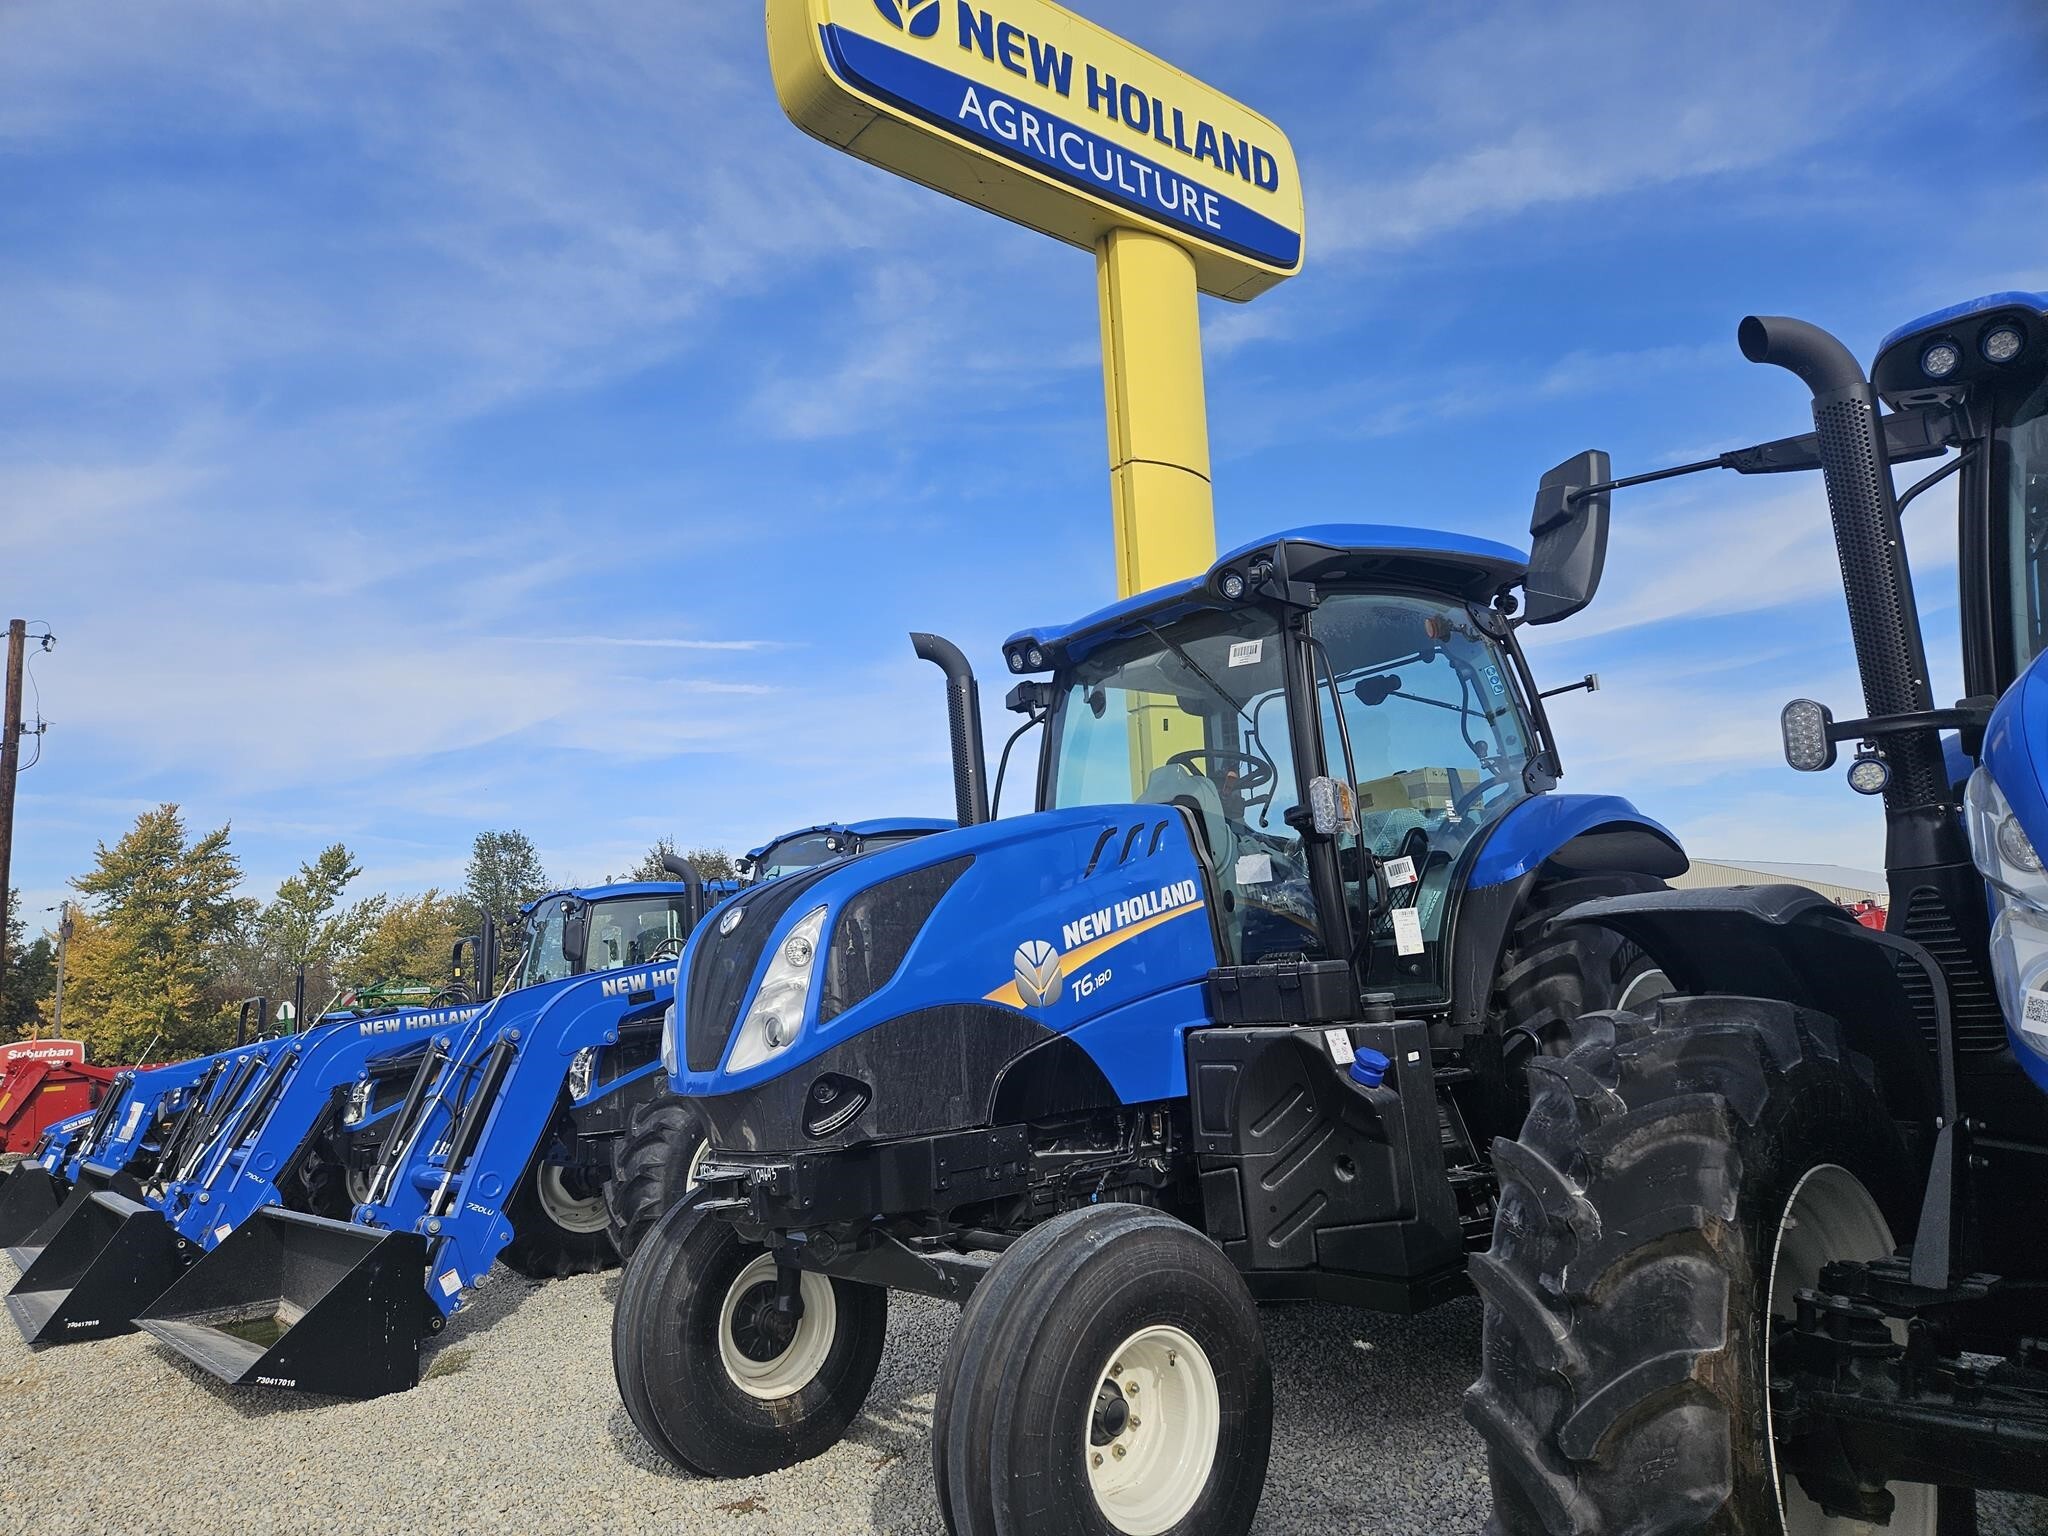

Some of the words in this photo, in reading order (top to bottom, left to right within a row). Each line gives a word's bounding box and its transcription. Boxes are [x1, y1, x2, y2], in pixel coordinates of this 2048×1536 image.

[958, 0, 1073, 98] NEW
[1086, 63, 1278, 192] HOLLAND
[959, 87, 1221, 229] AGRICULTURE
[1062, 907, 1112, 950] NEW
[1115, 879, 1197, 928] HOLLAND
[601, 973, 647, 997] NEW
[1071, 968, 1112, 1003] T6.180
[360, 1018, 400, 1036] NEW
[7, 1048, 74, 1060] Suburban
[466, 1202, 495, 1216] 720LU
[255, 1376, 296, 1387] 730417016
